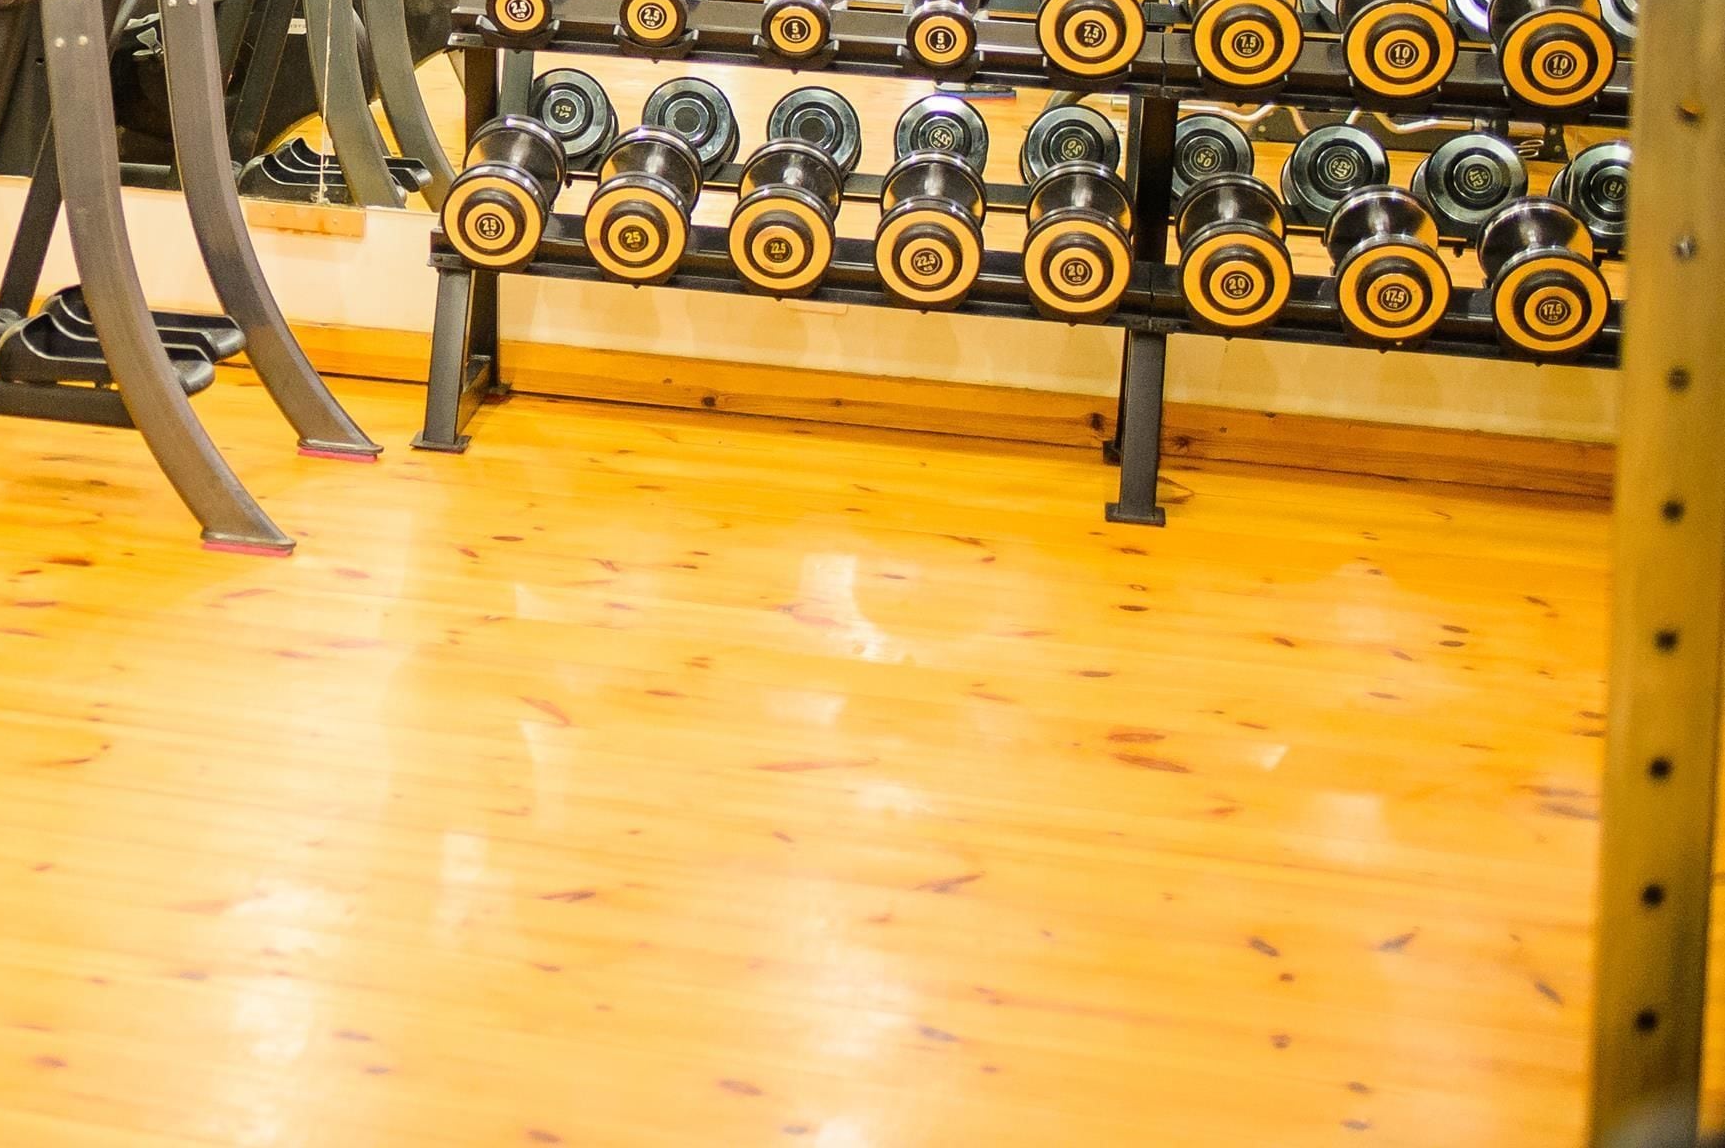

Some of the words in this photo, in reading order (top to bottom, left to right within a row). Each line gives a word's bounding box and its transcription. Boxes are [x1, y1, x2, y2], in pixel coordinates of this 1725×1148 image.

[510, 1, 527, 14] 2.5
[644, 8, 660, 22] 2.5
[792, 22, 799, 34] 5
[1084, 26, 1100, 39] 7.5
[937, 32, 944, 44] 5
[1240, 36, 1256, 48] 7.5
[1395, 45, 1410, 59] 10
[1553, 57, 1568, 70] 10
[482, 219, 497, 231] 25
[625, 231, 641, 244] 25
[916, 254, 936, 267] 22.5
[1067, 264, 1085, 277] 20
[1229, 277, 1245, 290] 20
[1386, 290, 1405, 303] 17.5
[1543, 303, 1563, 316] 17.5
